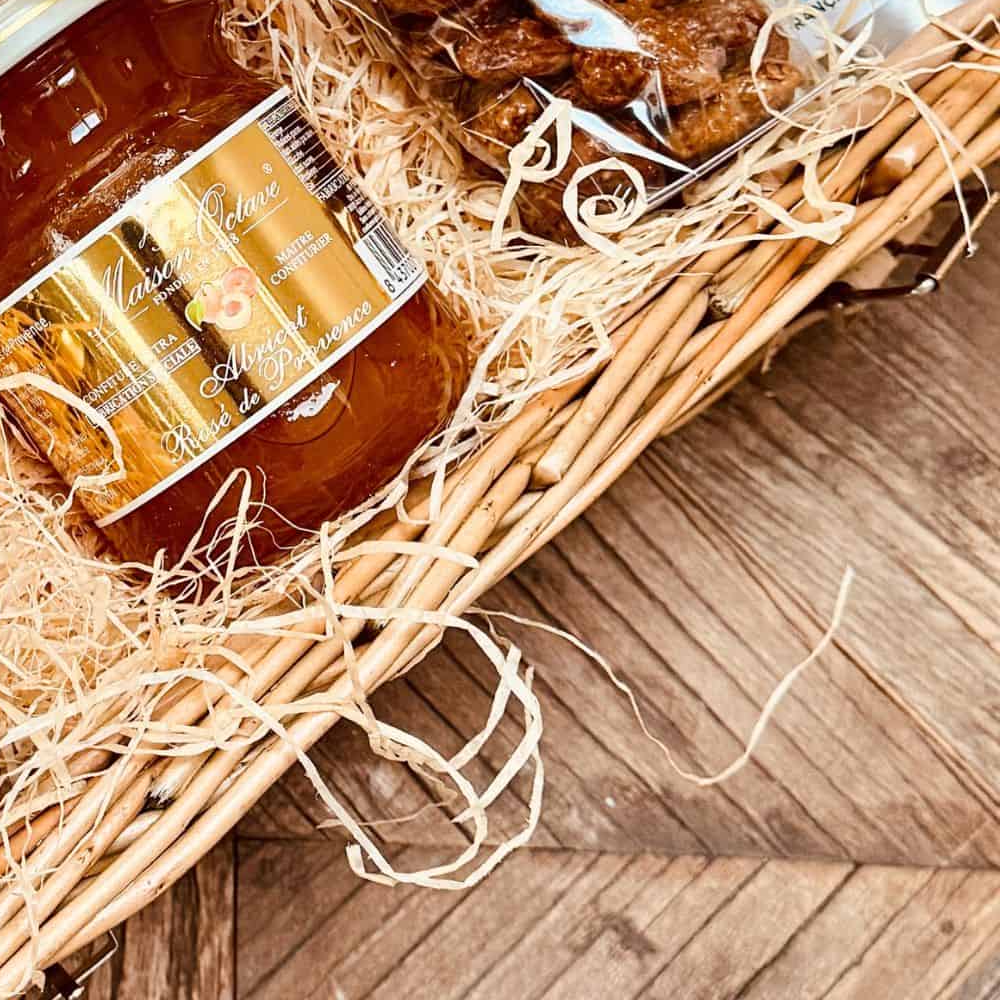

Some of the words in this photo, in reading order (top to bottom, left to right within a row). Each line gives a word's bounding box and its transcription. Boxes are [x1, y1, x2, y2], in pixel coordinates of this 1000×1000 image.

[94, 248, 194, 324] Maison
[196, 180, 280, 243] Octave
[199, 304, 309, 400] Abricot
[239, 386, 260, 415] de
